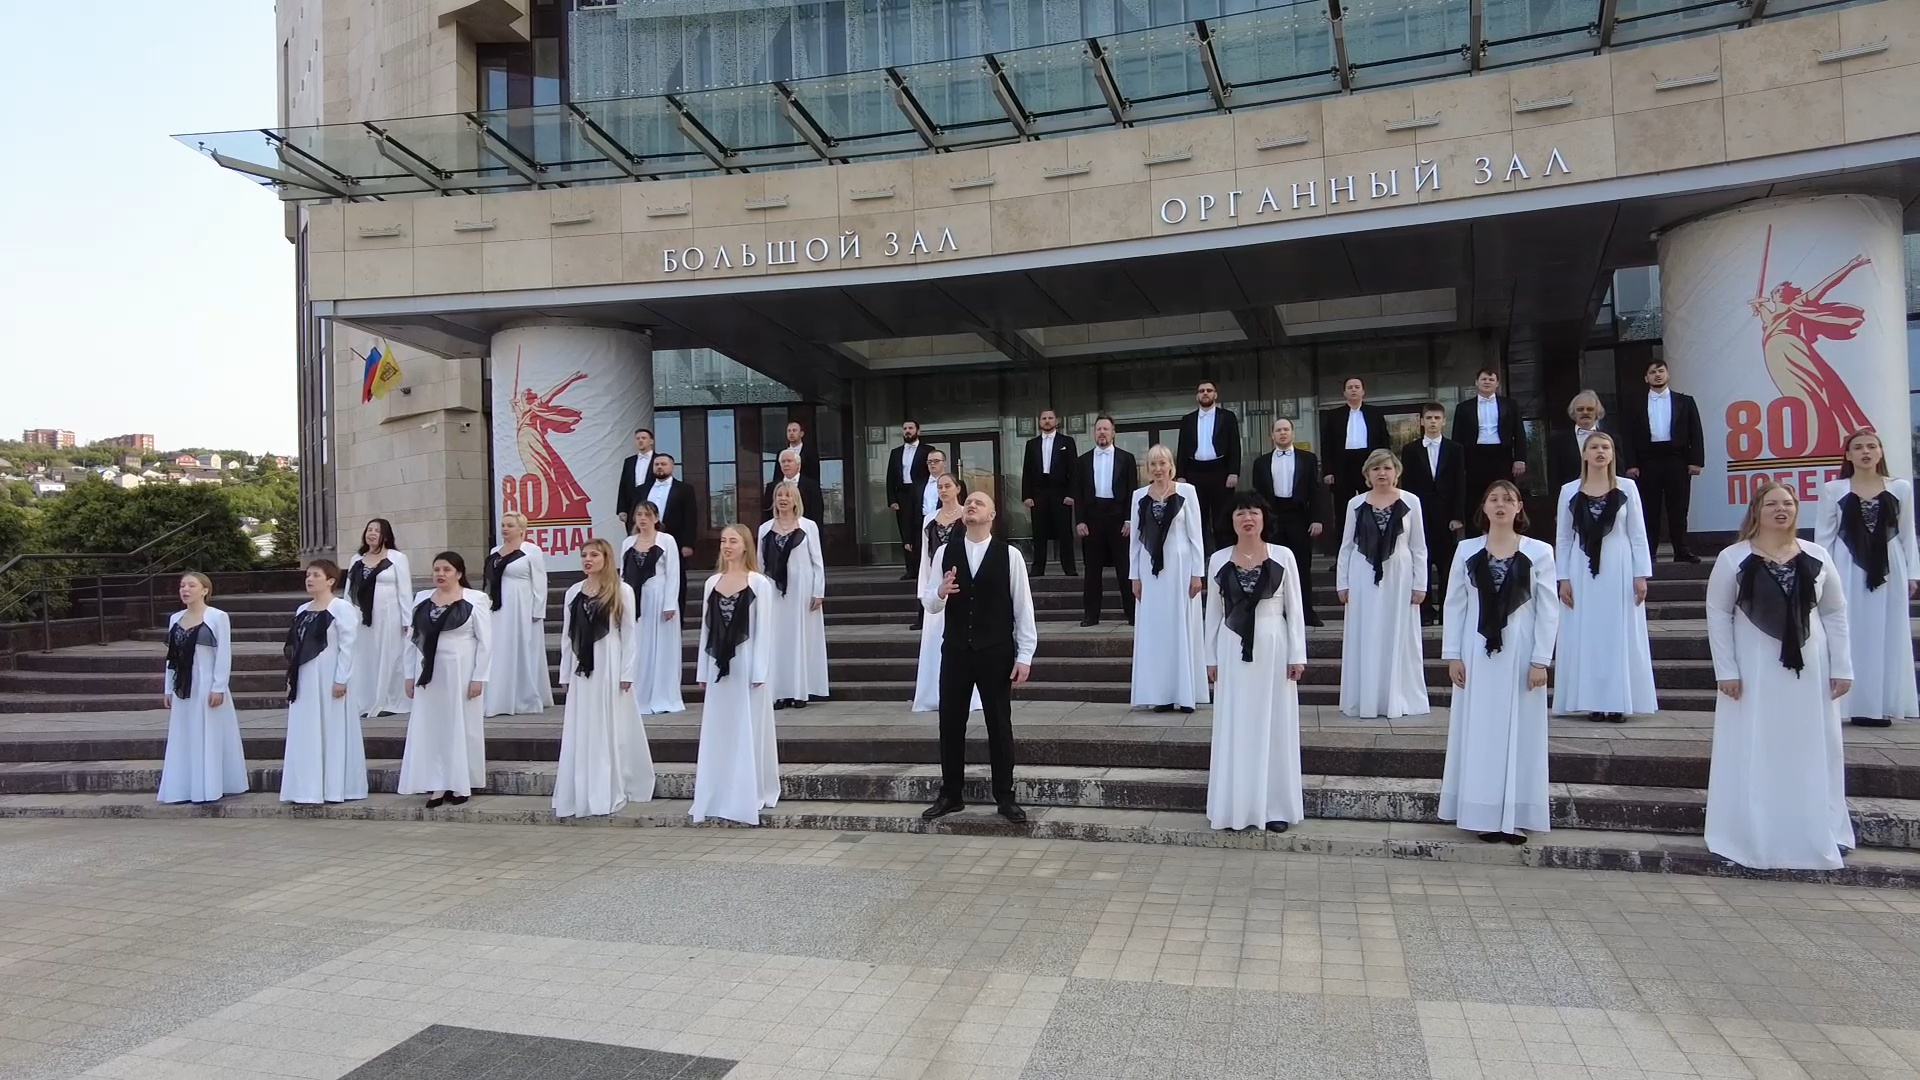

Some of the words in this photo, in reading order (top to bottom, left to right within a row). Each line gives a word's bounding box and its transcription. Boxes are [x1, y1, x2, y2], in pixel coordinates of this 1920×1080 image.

[1159, 157, 1442, 225] ОРГАННЫЙ
[1473, 146, 1572, 185] ЗАЛ
[662, 229, 862, 273] БОЛЬШОЙ
[883, 226, 959, 257] ЗАЛ
[1725, 395, 1809, 461] 80
[502, 473, 542, 520] 80
